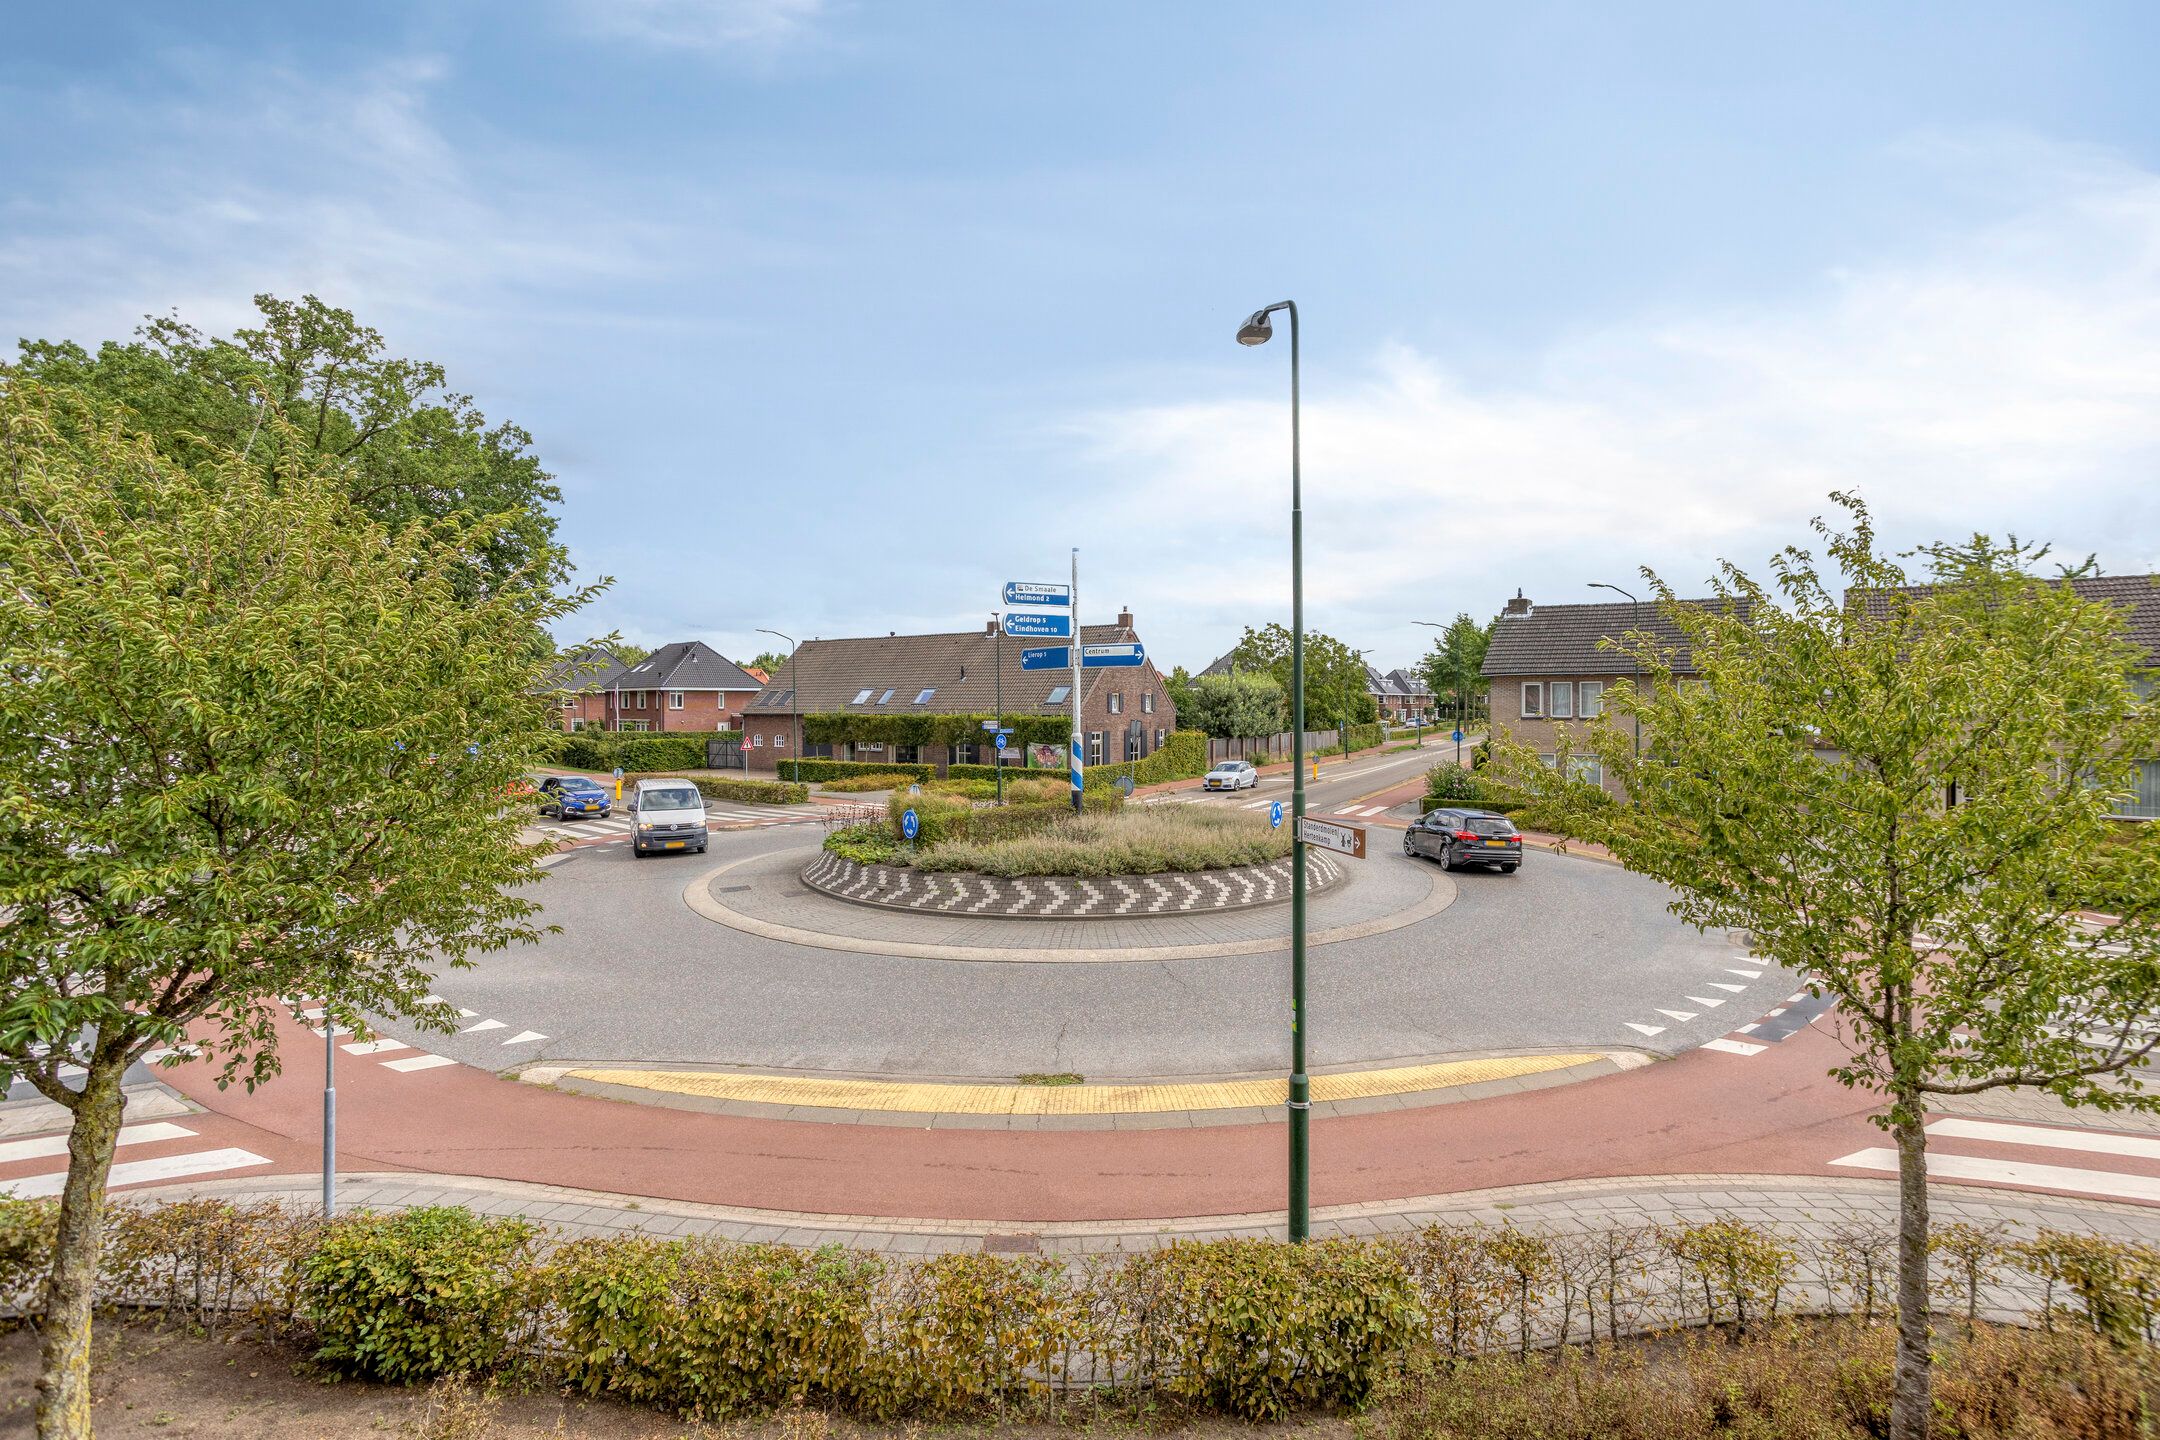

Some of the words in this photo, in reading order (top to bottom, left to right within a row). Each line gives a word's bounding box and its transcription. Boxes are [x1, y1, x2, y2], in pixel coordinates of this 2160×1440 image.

[1015, 593, 1045, 602] Helmond
[1015, 615, 1041, 624] Geldrop
[1015, 625, 1050, 633] Eindhoven
[1027, 651, 1043, 659] Lierop
